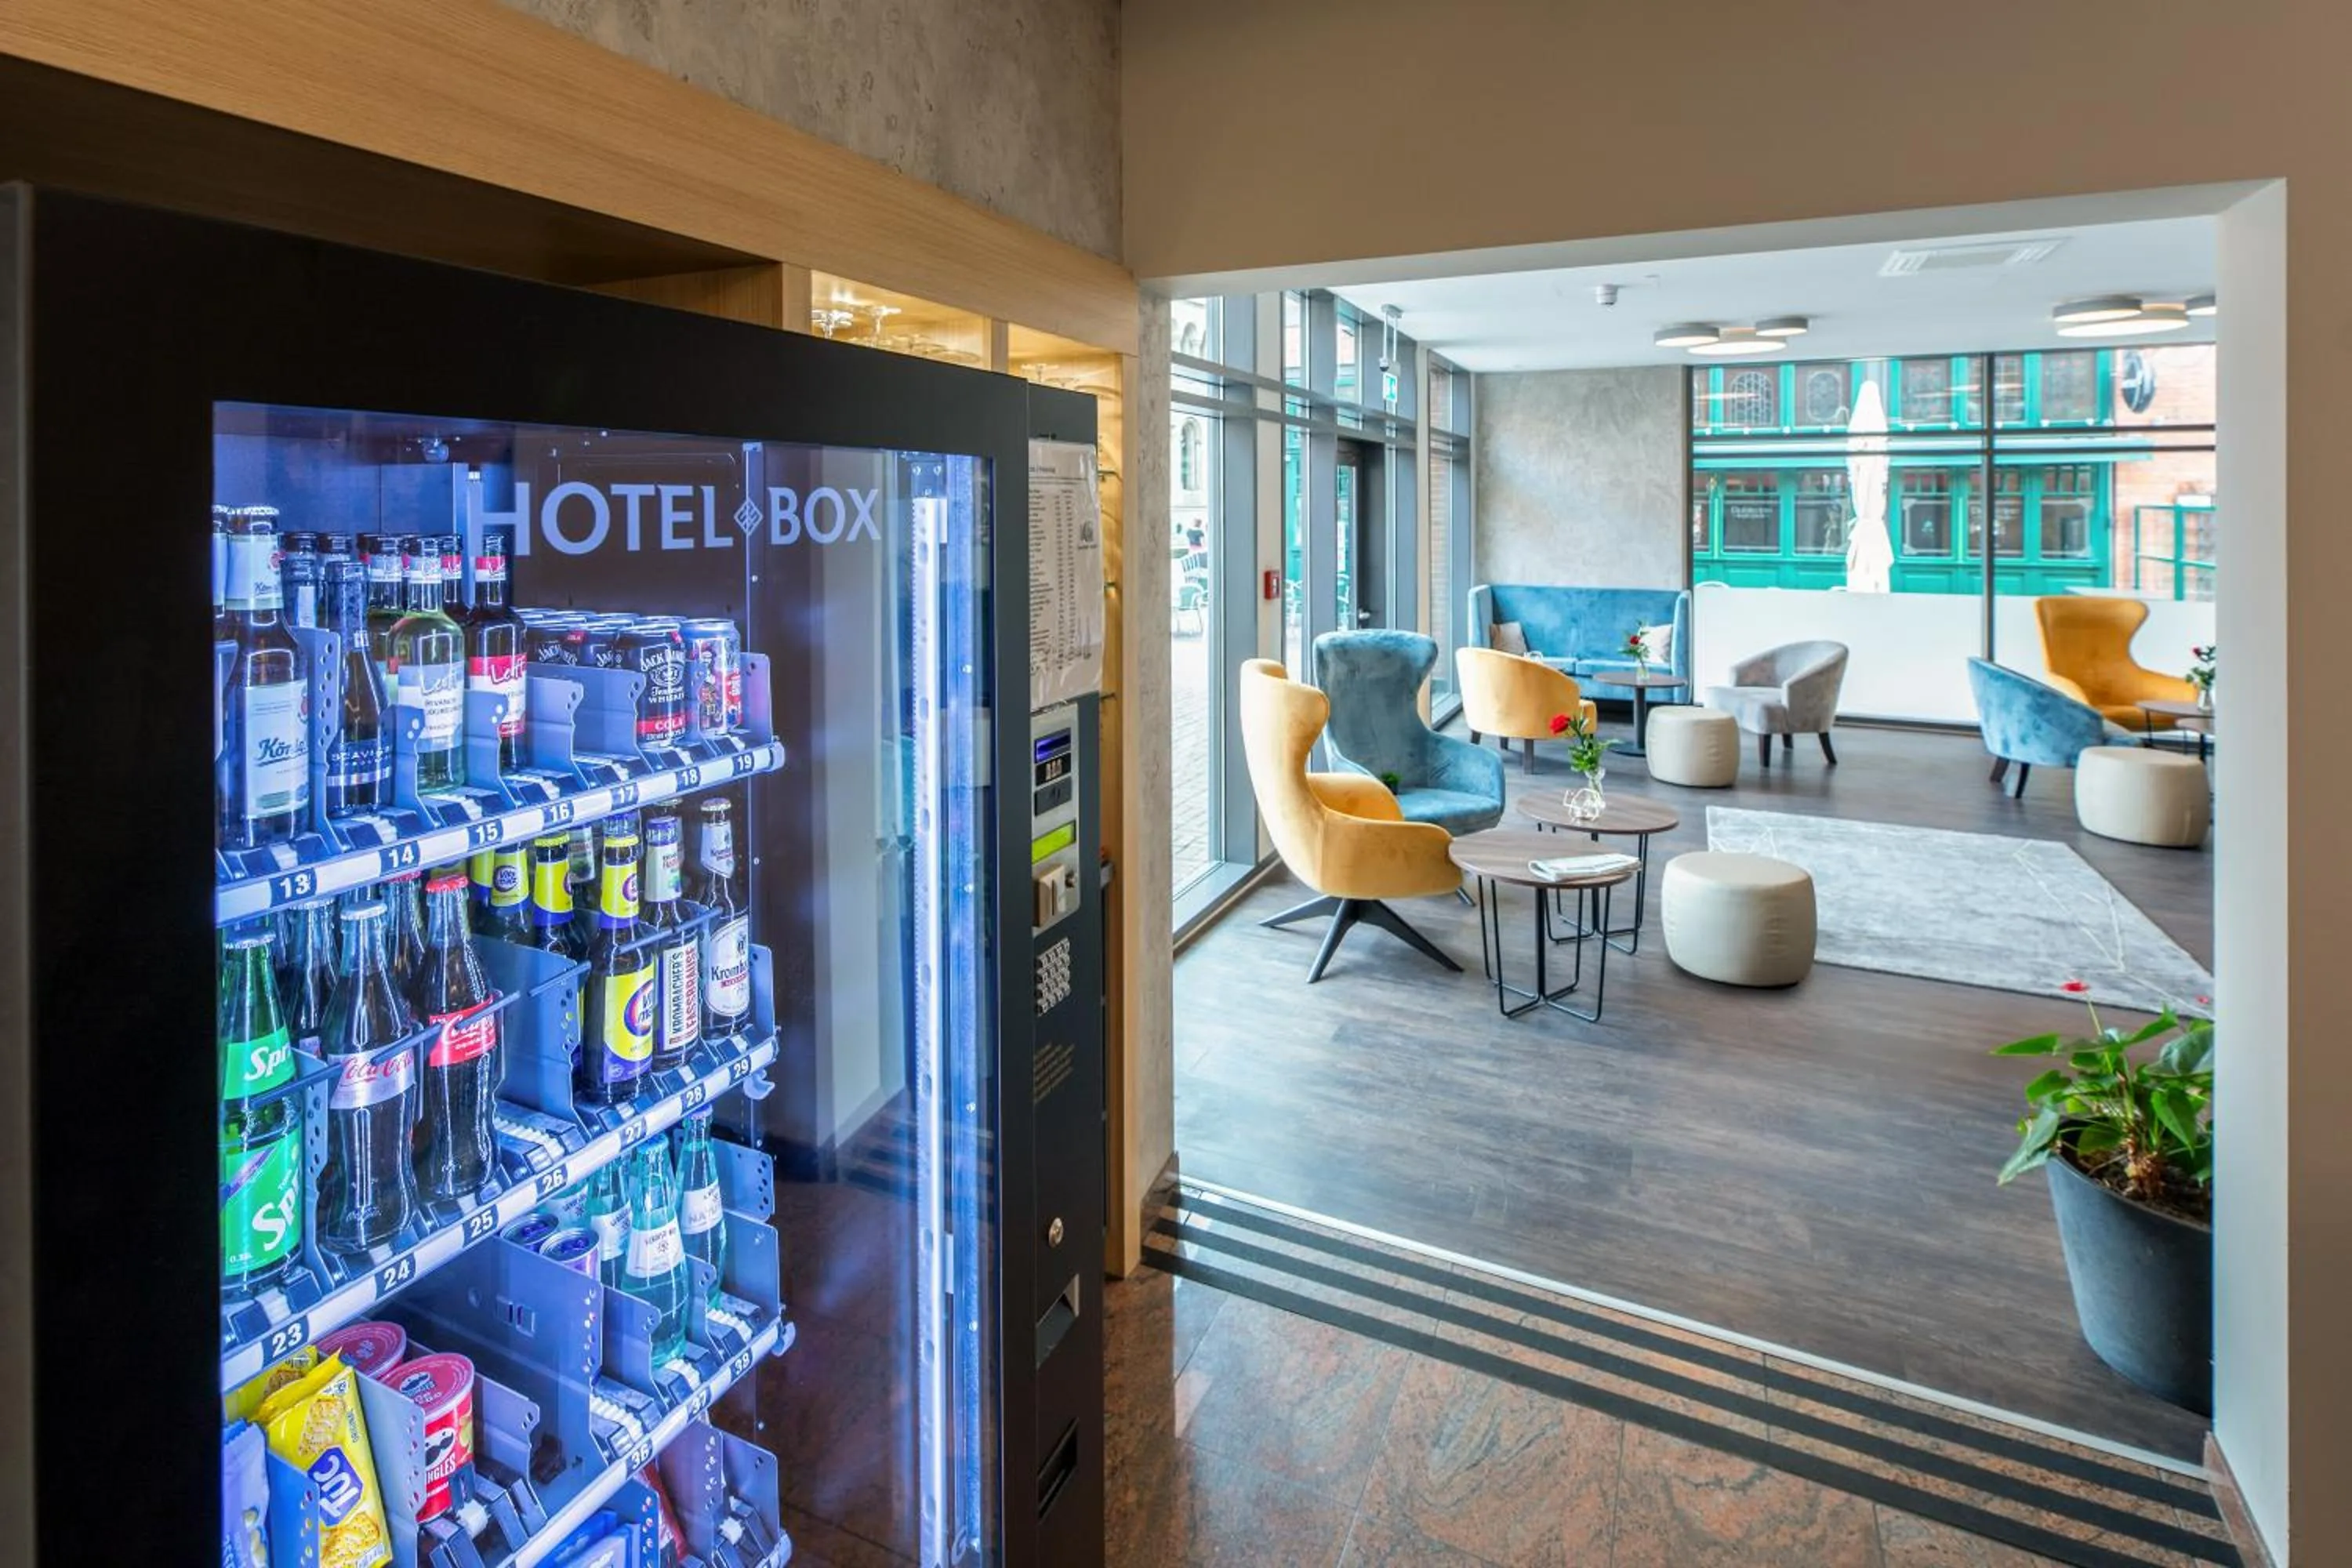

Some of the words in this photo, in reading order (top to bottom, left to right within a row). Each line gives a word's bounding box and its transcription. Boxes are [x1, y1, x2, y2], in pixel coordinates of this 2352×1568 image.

[468, 481, 734, 556] HOTEL
[768, 486, 880, 545] BOX
[737, 755, 752, 770] 19
[681, 768, 698, 786] 18
[619, 785, 635, 804] 17
[550, 804, 570, 819] 16
[475, 823, 499, 844] 15
[388, 842, 415, 869] 14
[279, 874, 310, 898] 13
[685, 946, 697, 1029] FASSBRAUSE
[733, 1058, 749, 1079] 29
[685, 1086, 703, 1109] 28
[625, 1120, 642, 1141] 27
[541, 1168, 564, 1192] 26
[470, 1209, 494, 1239] 25
[383, 1259, 411, 1292] 24
[271, 1322, 302, 1359] 23
[630, 1443, 650, 1470] 36
[313, 1454, 360, 1519] TUC
